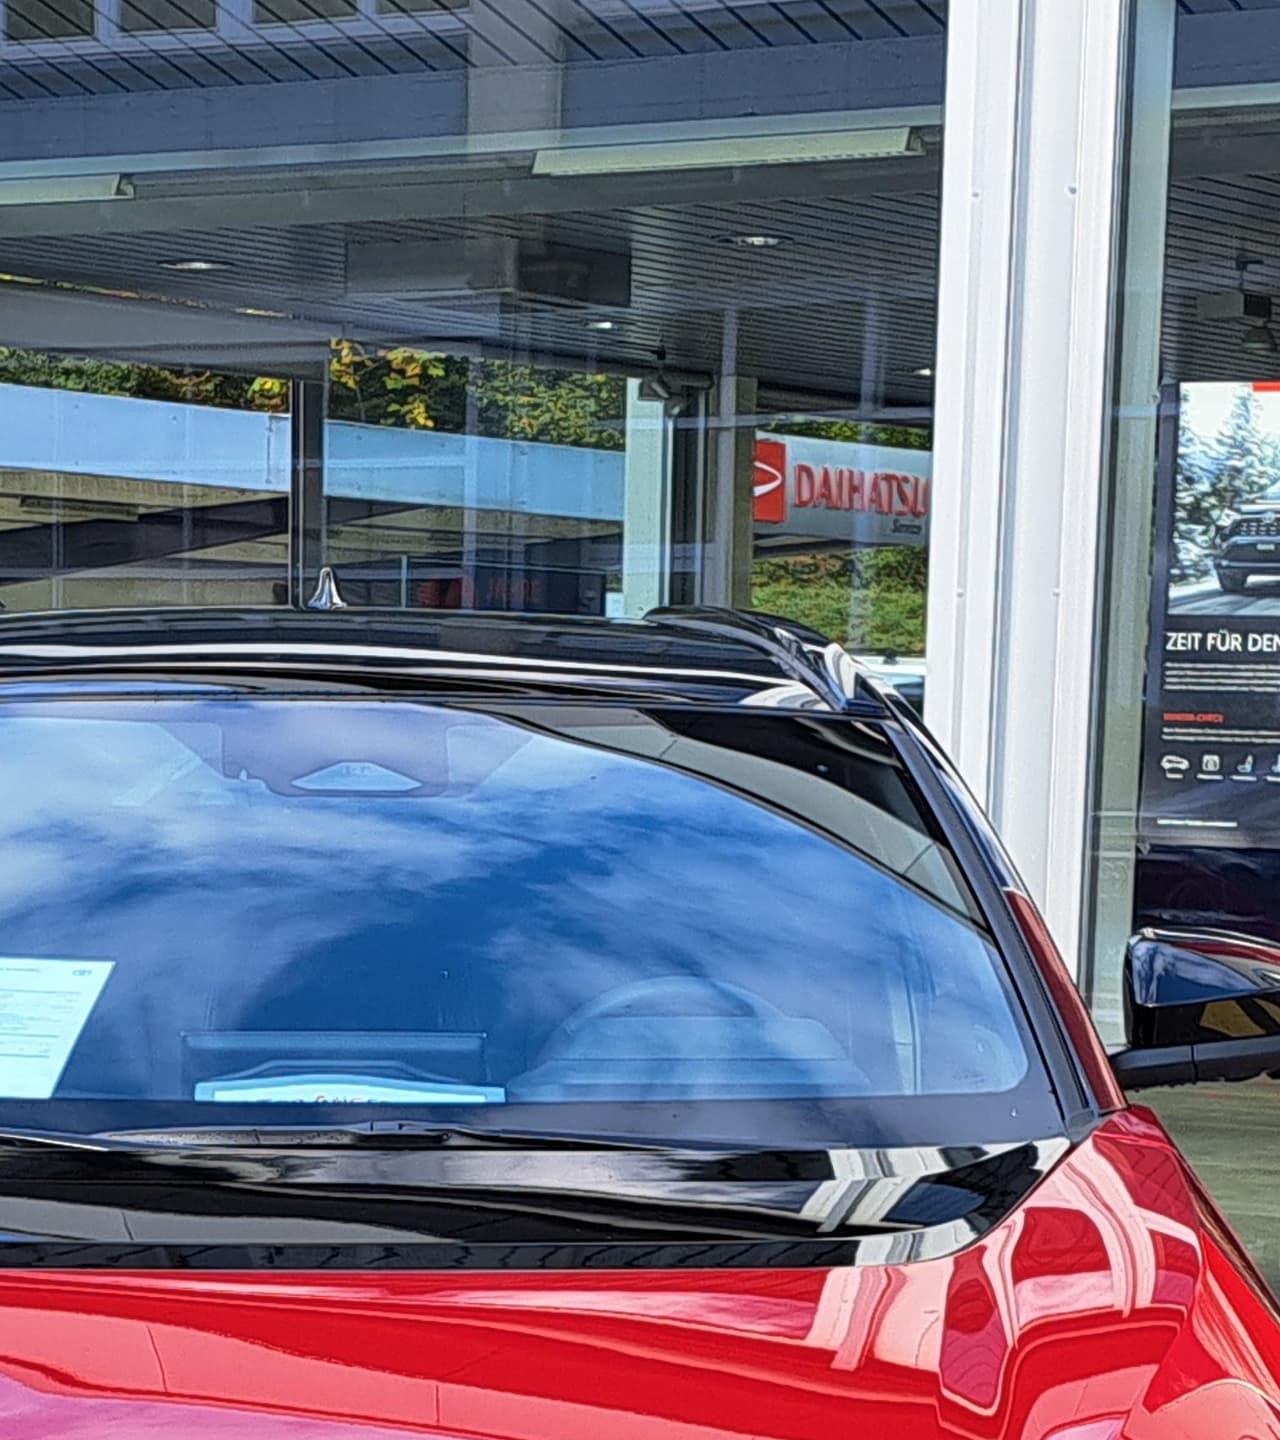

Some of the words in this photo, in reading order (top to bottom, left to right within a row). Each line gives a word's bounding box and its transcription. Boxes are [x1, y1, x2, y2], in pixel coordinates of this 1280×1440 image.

[793, 463, 929, 518] DAIHATSU
[1165, 631, 1202, 651] ZEIT
[1206, 628, 1242, 652] FÜR
